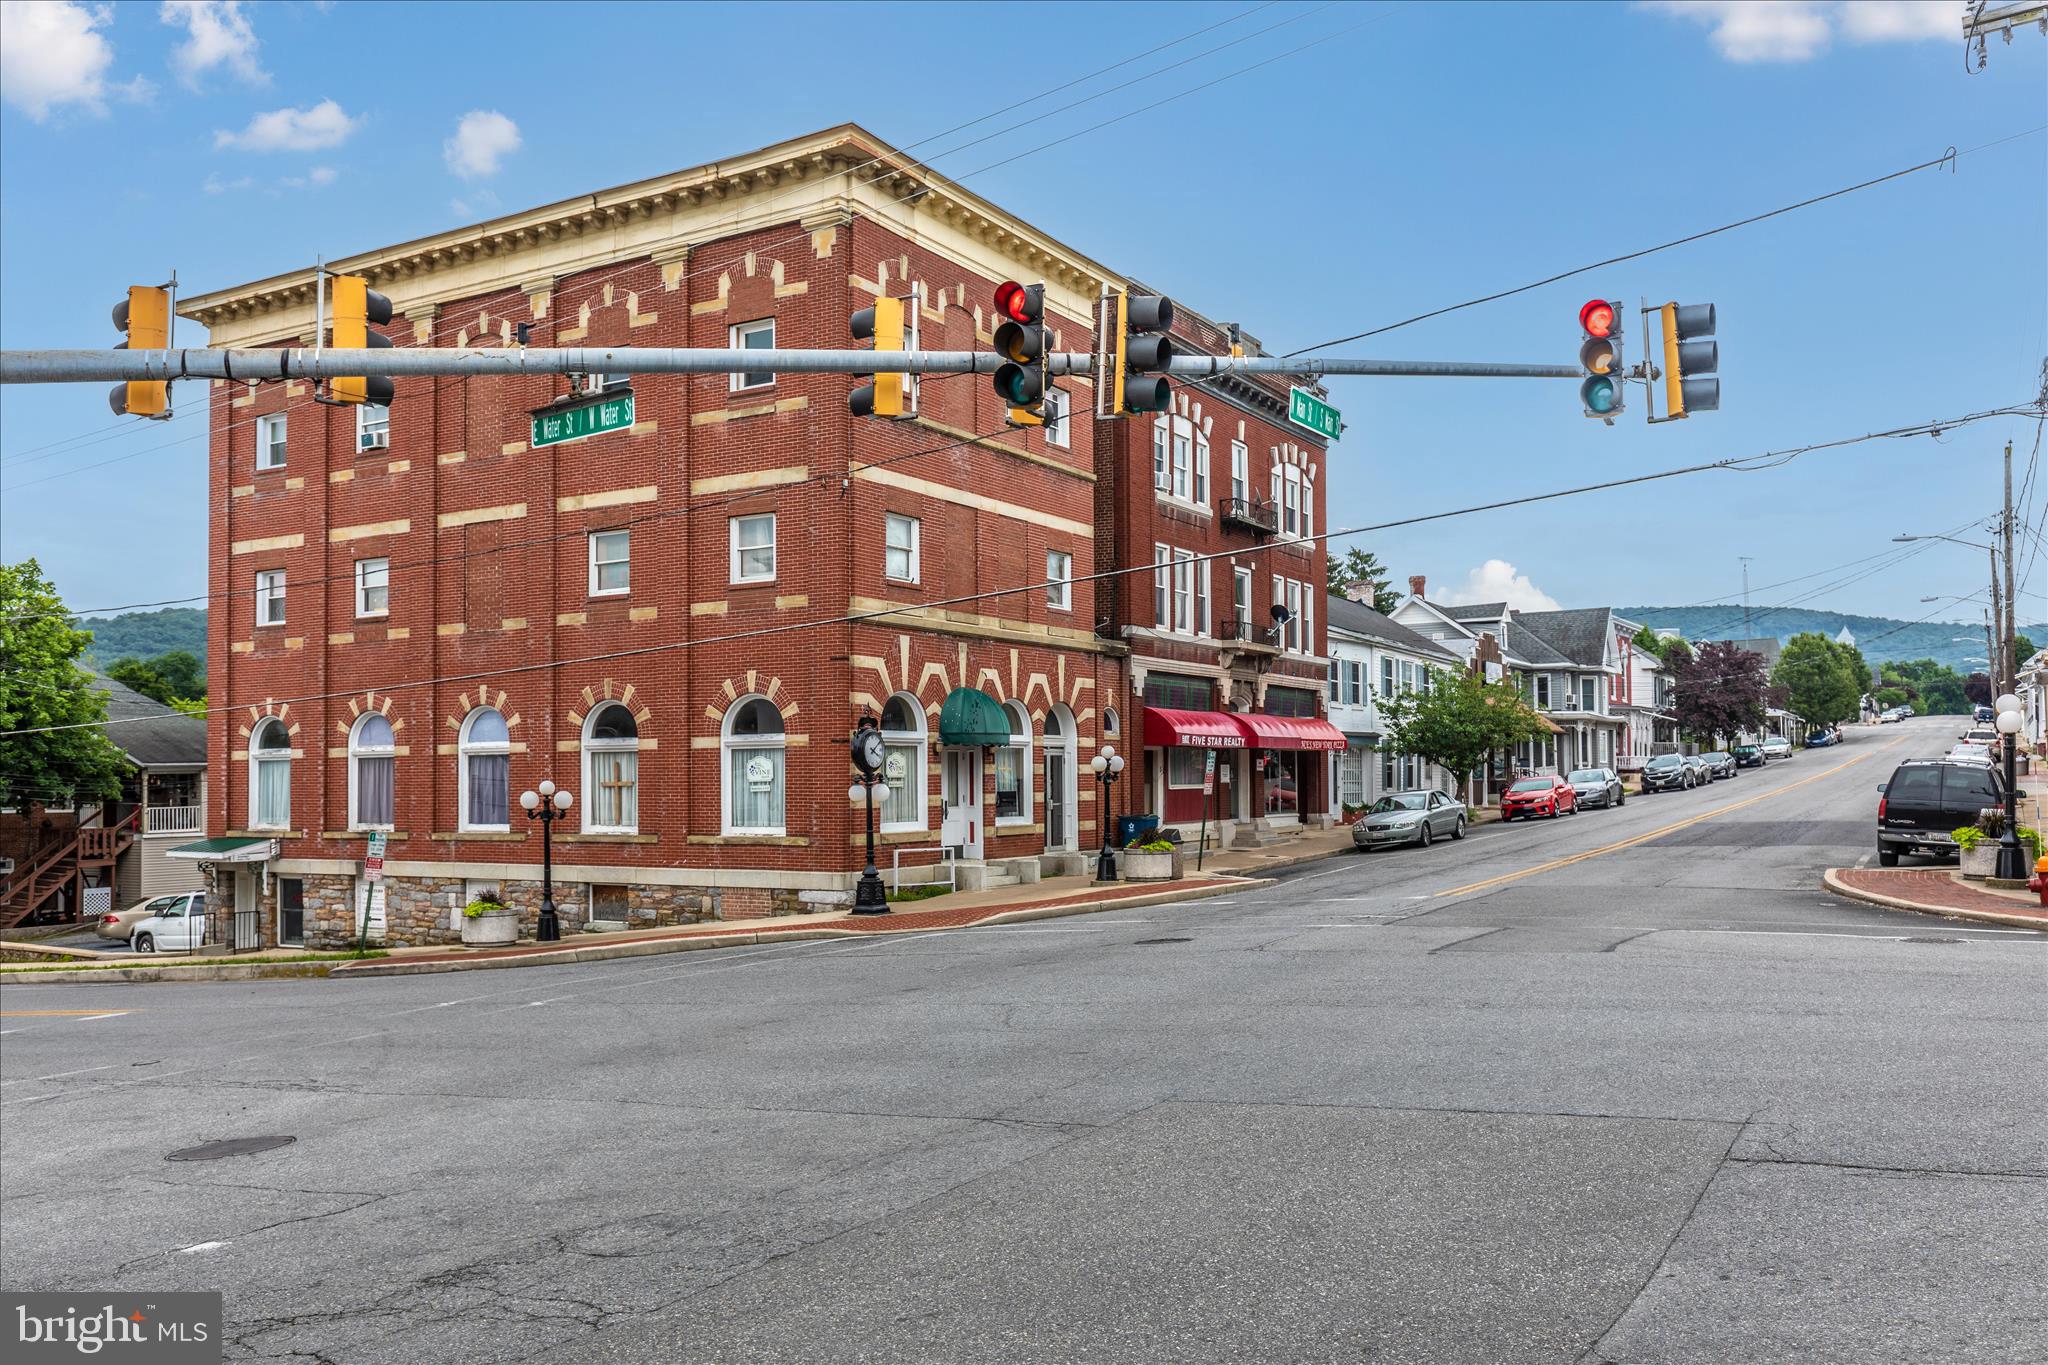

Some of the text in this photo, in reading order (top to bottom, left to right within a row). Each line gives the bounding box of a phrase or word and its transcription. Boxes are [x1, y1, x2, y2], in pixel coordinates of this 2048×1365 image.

[534, 397, 633, 442] E Water St / W Water St
[1192, 736, 1206, 745] FIVE
[1207, 737, 1222, 746] STAR
[1224, 738, 1246, 746] REALTY
